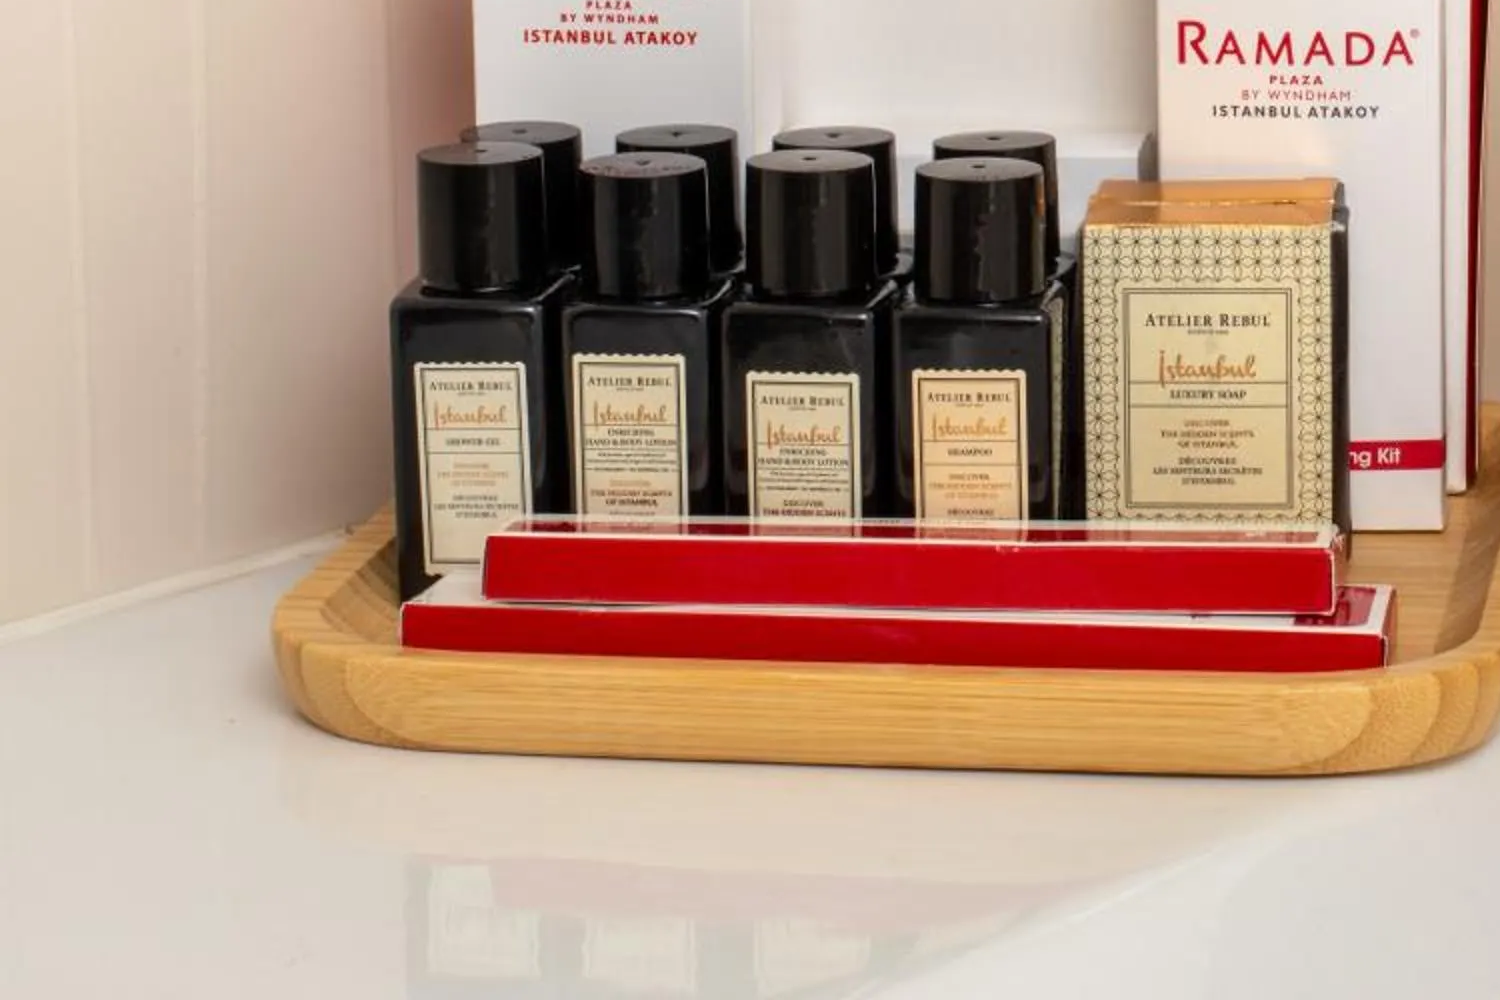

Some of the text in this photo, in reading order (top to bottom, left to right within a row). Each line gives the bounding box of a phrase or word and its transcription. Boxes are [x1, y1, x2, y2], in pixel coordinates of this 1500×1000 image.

[585, 0, 632, 10] PLAZA
[560, 13, 660, 24] BY WYNDHAM
[523, 29, 698, 45] ISTANBUL ATAKOY
[1177, 20, 1415, 66] RAMADA
[1269, 75, 1324, 85] PLAZA
[1241, 90, 1351, 101] BY WYNDHAM
[1212, 105, 1380, 119] ISTANBUL ATAKOY
[1145, 314, 1271, 328] ATELIER REBUL
[1170, 390, 1247, 399] LUXURY SOAP
[1377, 447, 1400, 465] Kit
